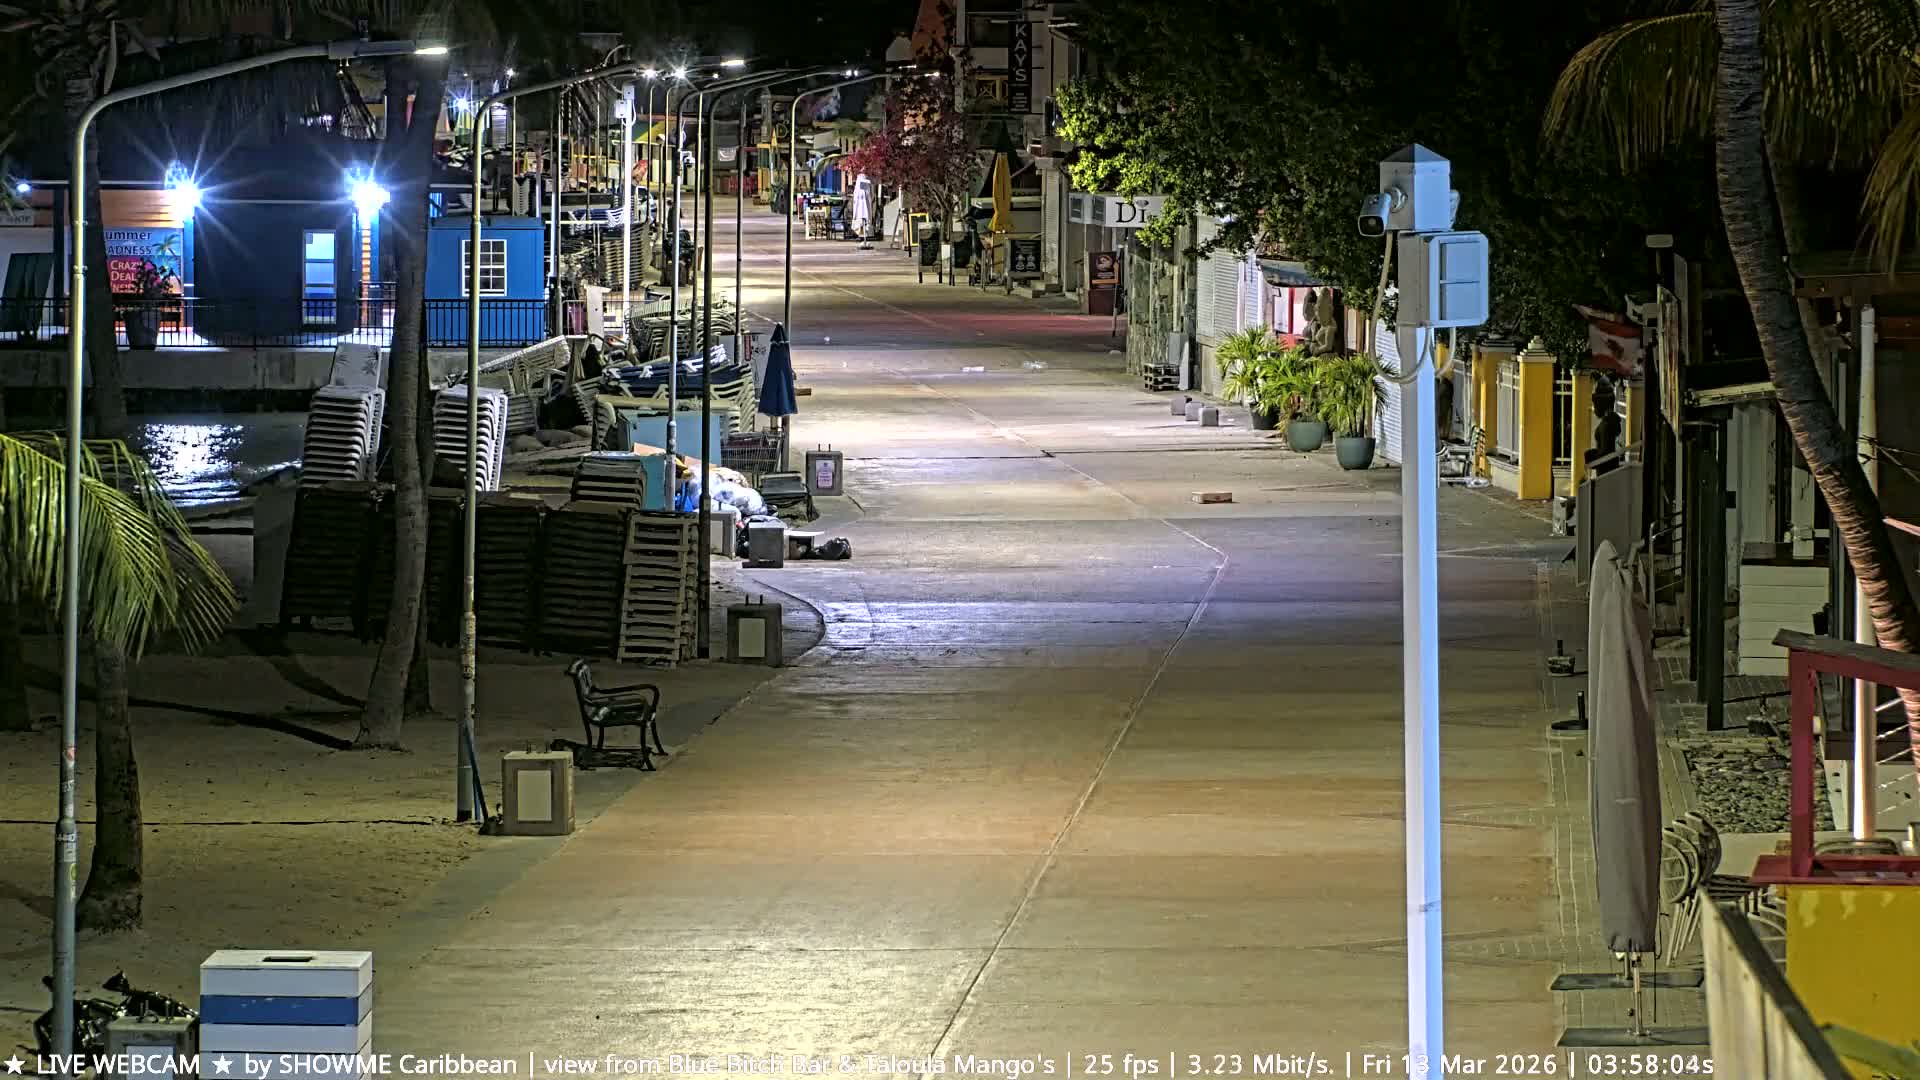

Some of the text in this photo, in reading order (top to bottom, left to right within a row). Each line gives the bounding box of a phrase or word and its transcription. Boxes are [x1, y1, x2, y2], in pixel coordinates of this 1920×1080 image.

[1013, 23, 1027, 82] KAY'S
[1115, 199, 1149, 223] Di
[105, 231, 152, 240] ummer
[107, 245, 152, 255] ADNESS
[111, 271, 137, 281] DEAL
